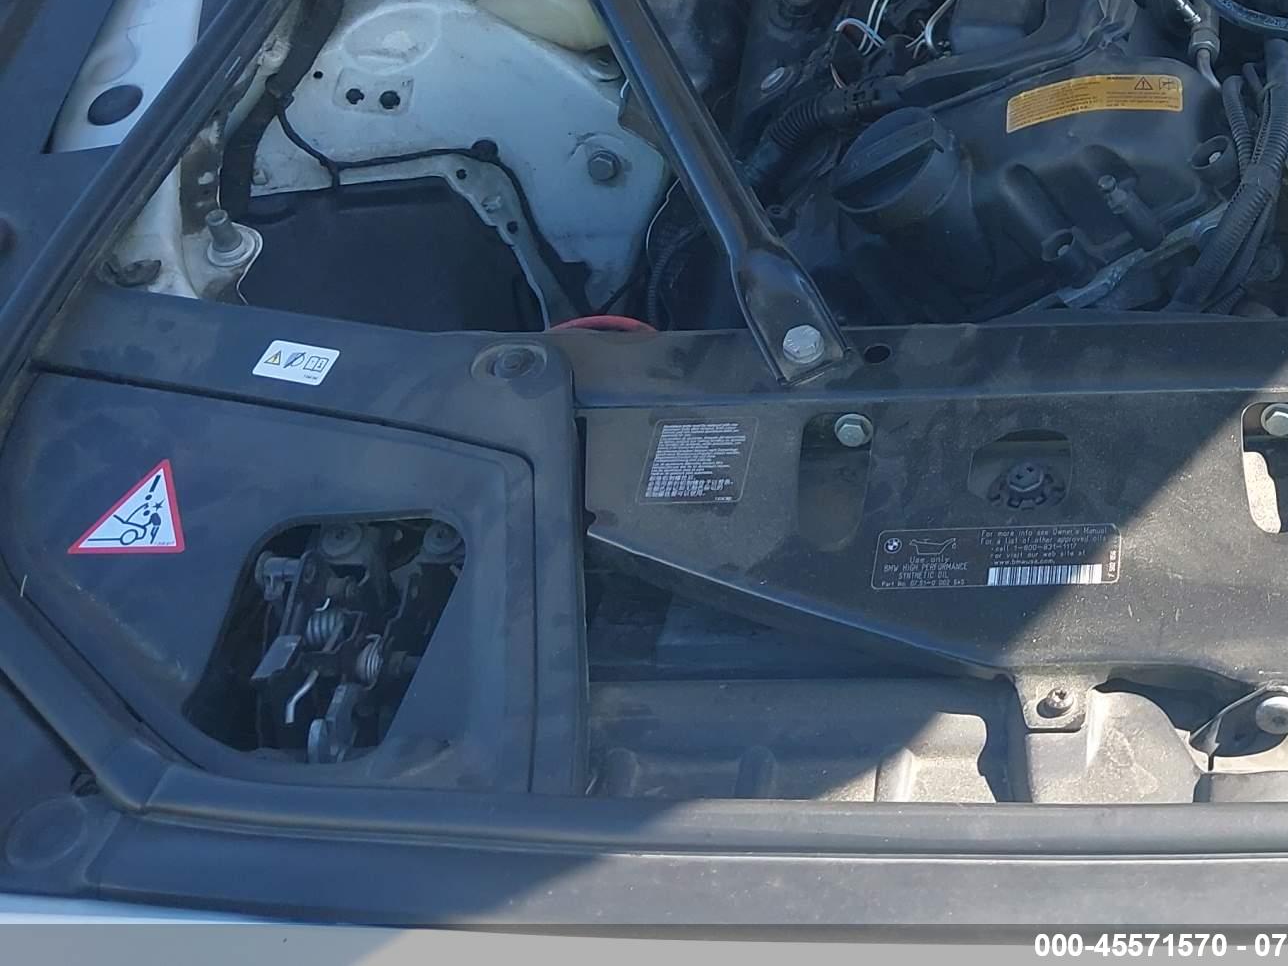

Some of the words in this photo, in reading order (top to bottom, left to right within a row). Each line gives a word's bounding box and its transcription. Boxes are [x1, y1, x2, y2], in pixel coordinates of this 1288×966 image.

[1018, 529, 1033, 537] info
[1057, 535, 1090, 544] approved
[909, 556, 925, 564] Use
[930, 554, 950, 564] only
[1006, 551, 1023, 559] visit
[883, 564, 899, 573] BMW
[902, 564, 919, 572] HIGH
[921, 561, 968, 571] PERFORMANCE
[898, 572, 934, 580] SYNTHETIC
[937, 571, 950, 579] OIL
